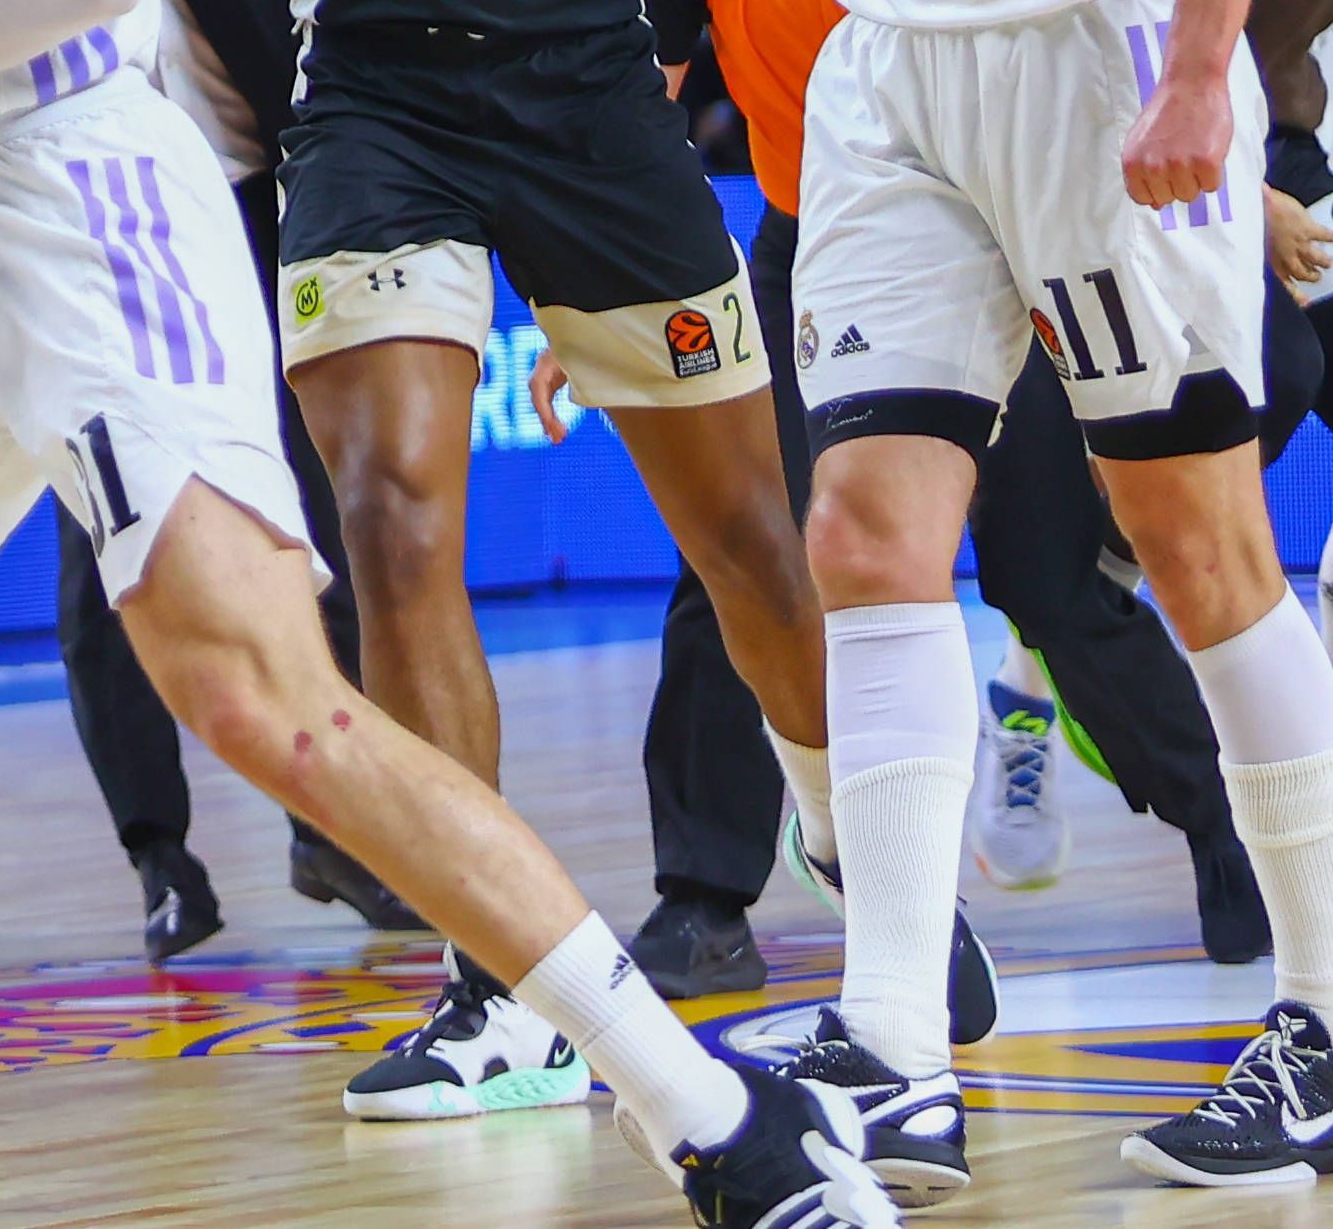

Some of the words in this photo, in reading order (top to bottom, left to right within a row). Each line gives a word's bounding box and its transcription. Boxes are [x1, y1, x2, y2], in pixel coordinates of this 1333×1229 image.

[723, 292, 751, 364] 2
[831, 339, 870, 359] adidas
[1042, 268, 1148, 381] 11
